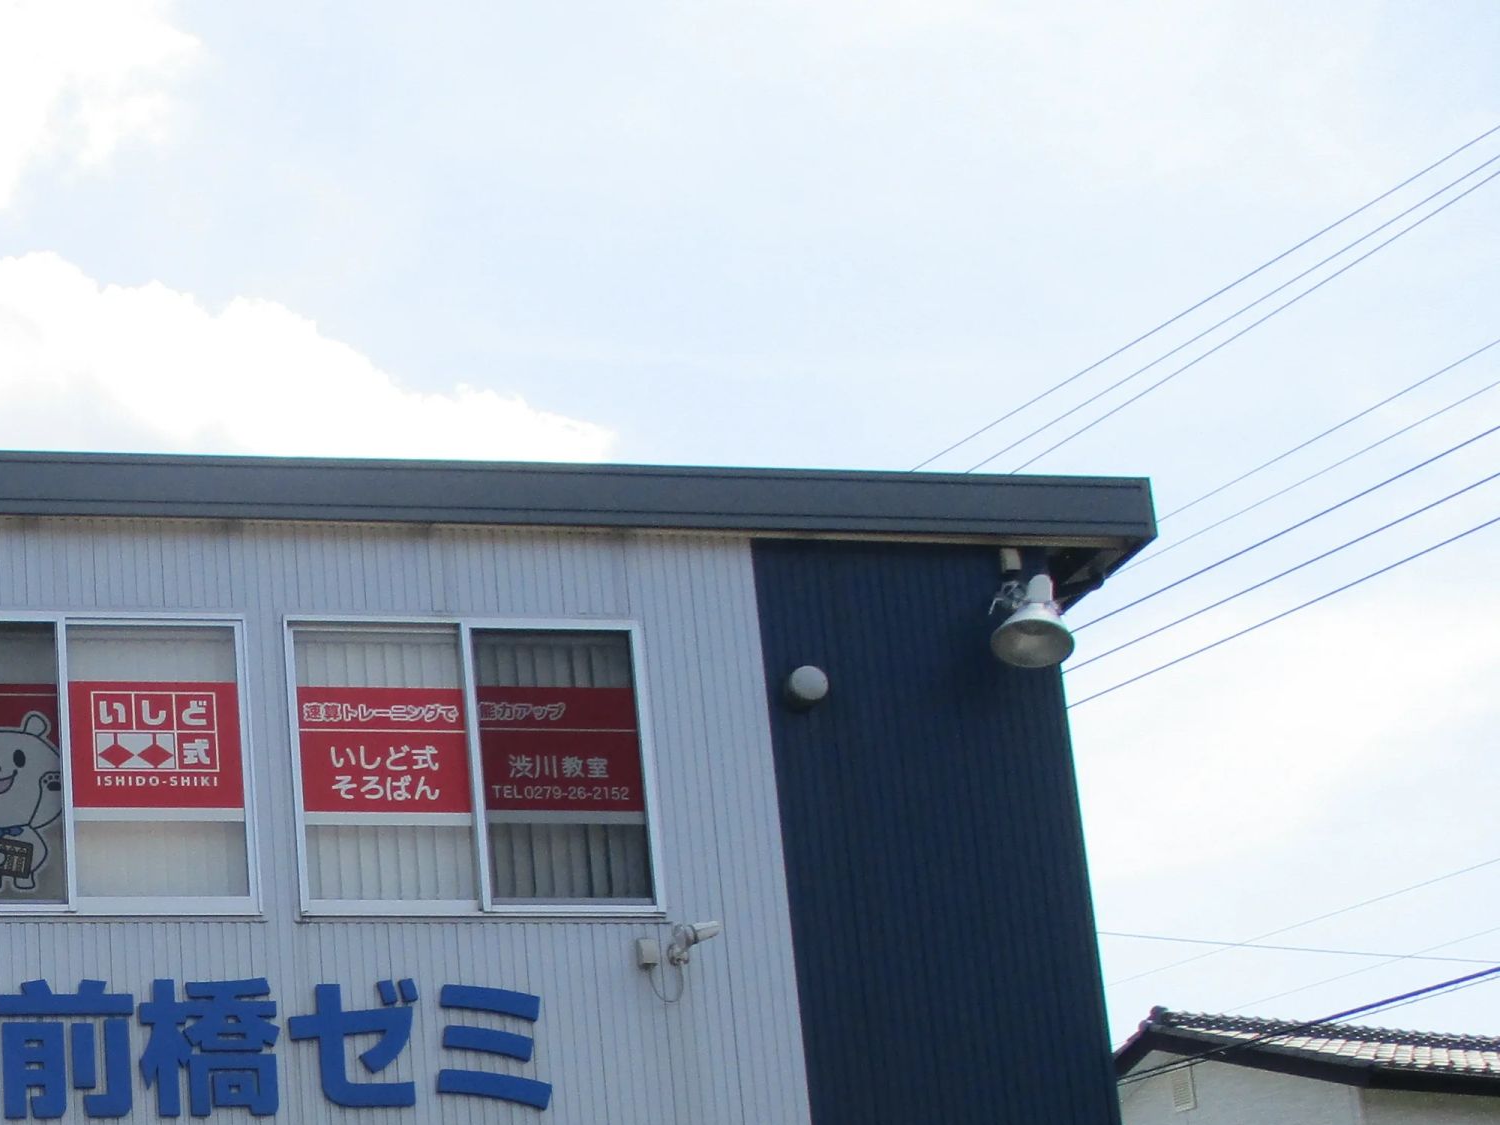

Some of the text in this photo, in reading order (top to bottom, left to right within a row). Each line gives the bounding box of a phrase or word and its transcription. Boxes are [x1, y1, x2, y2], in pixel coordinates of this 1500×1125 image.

[99, 699, 207, 726] いしど
[303, 702, 459, 723] 速算トレーニングで
[182, 738, 211, 765] 式
[330, 745, 439, 771] いしど式
[509, 754, 609, 779] 渋川教室
[96, 775, 218, 787] ISHIDO-SHIKI
[332, 775, 440, 801] そろばん
